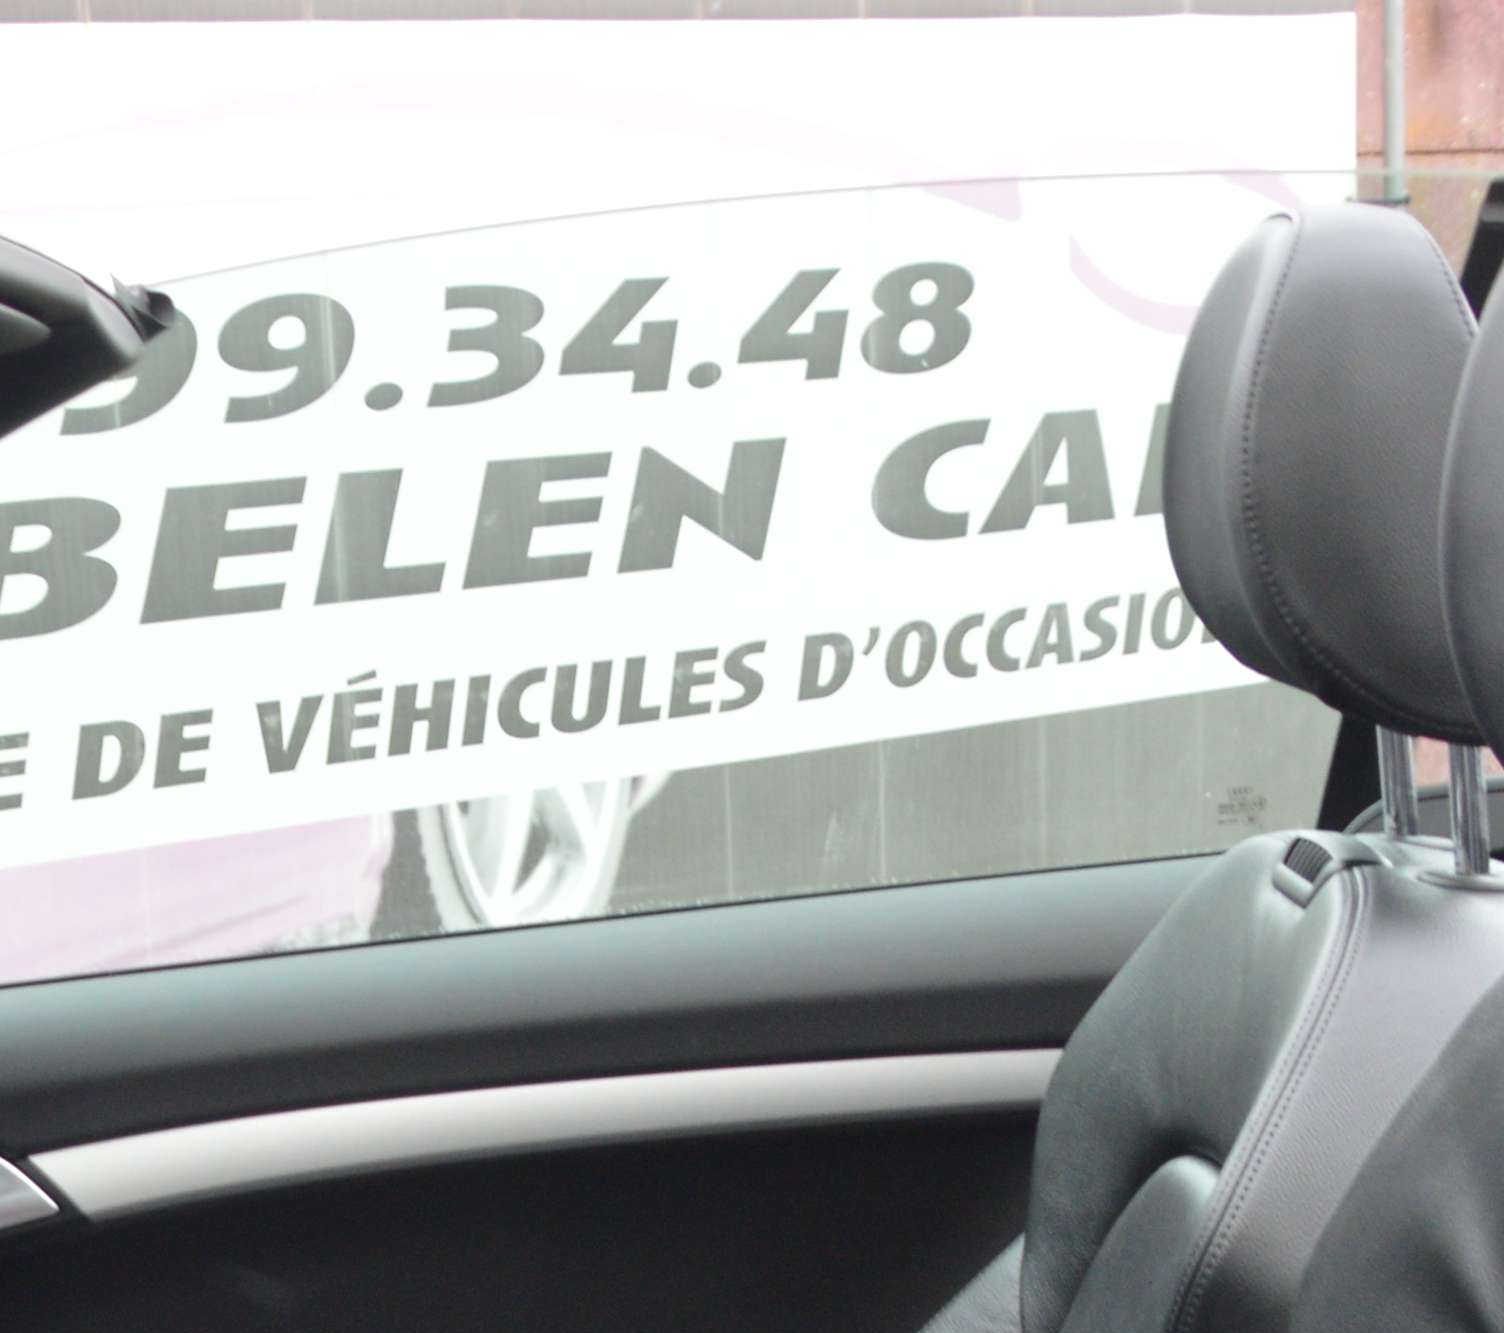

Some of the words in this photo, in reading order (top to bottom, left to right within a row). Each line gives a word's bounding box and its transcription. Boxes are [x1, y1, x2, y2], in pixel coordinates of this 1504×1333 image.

[71, 708, 214, 801] DE
[255, 639, 768, 774] VÉHICULES
[796, 586, 1218, 702] D'OCCASIO
